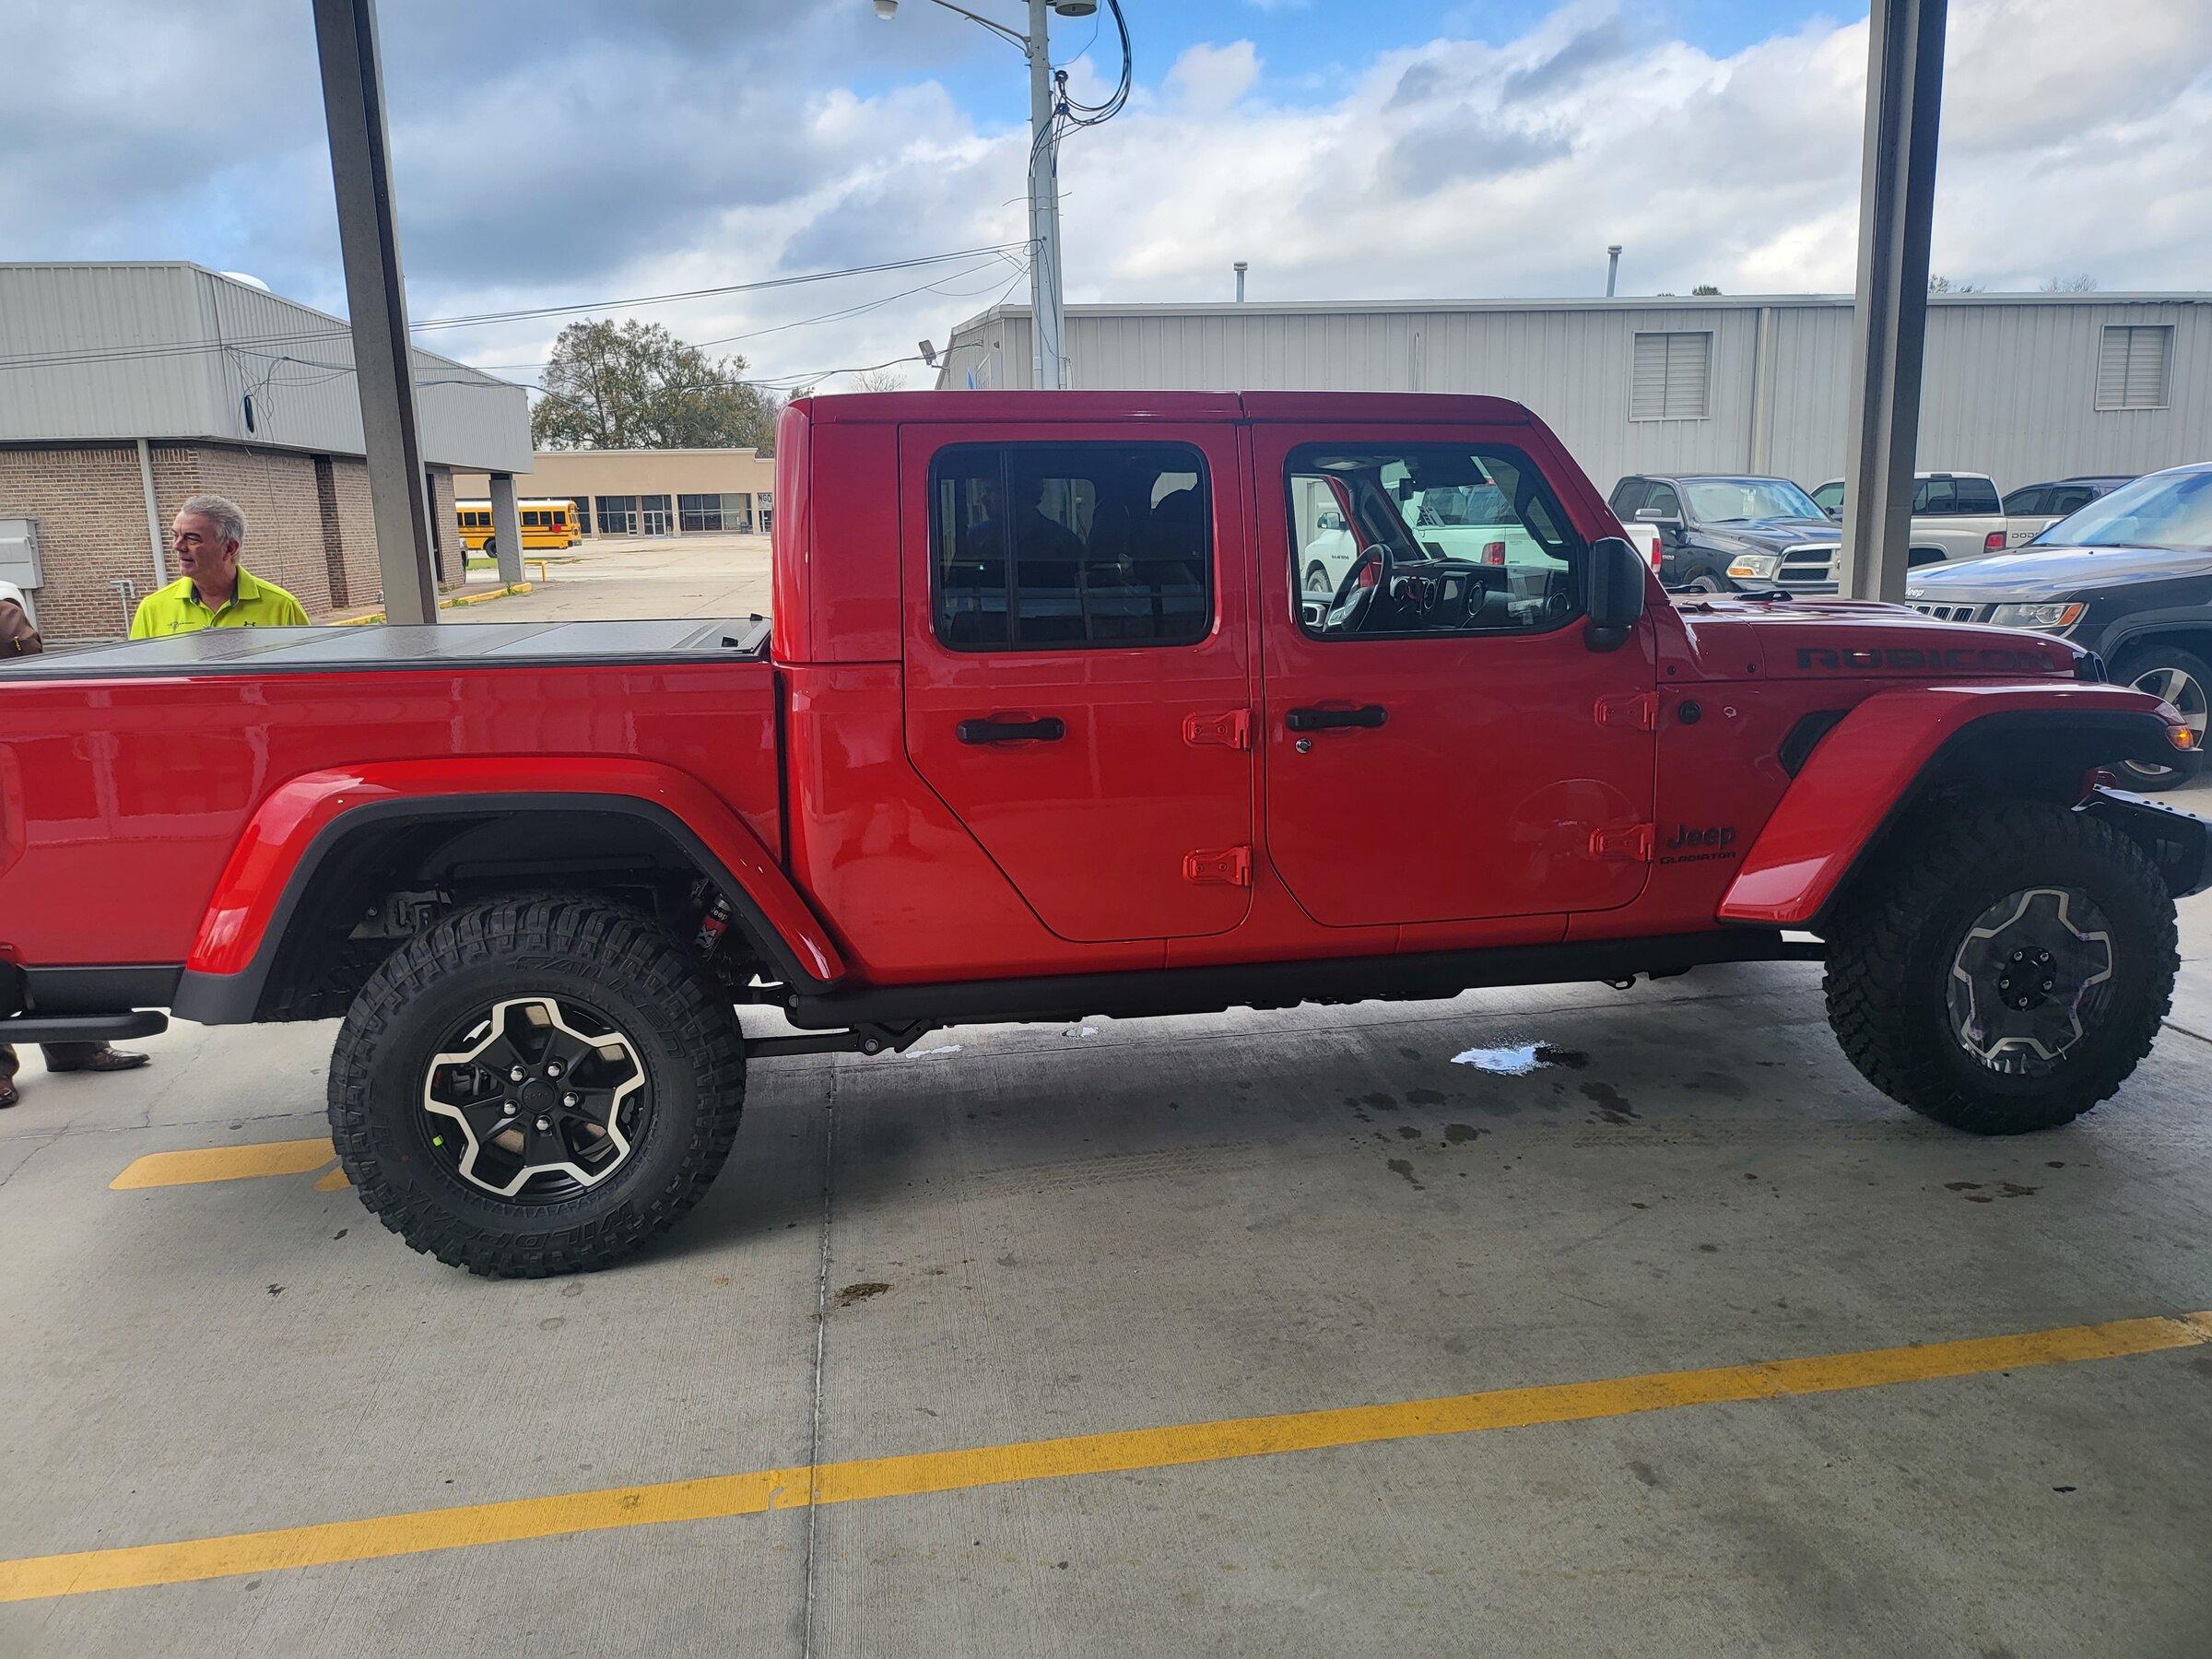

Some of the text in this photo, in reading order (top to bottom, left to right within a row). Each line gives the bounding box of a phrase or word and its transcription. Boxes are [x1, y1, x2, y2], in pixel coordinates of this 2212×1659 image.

[1796, 648, 2054, 670] RUBICON
[1666, 825, 1735, 851] Jeep
[1660, 852, 1736, 865] GLADIATOR
[710, 906, 728, 922] Jeep
